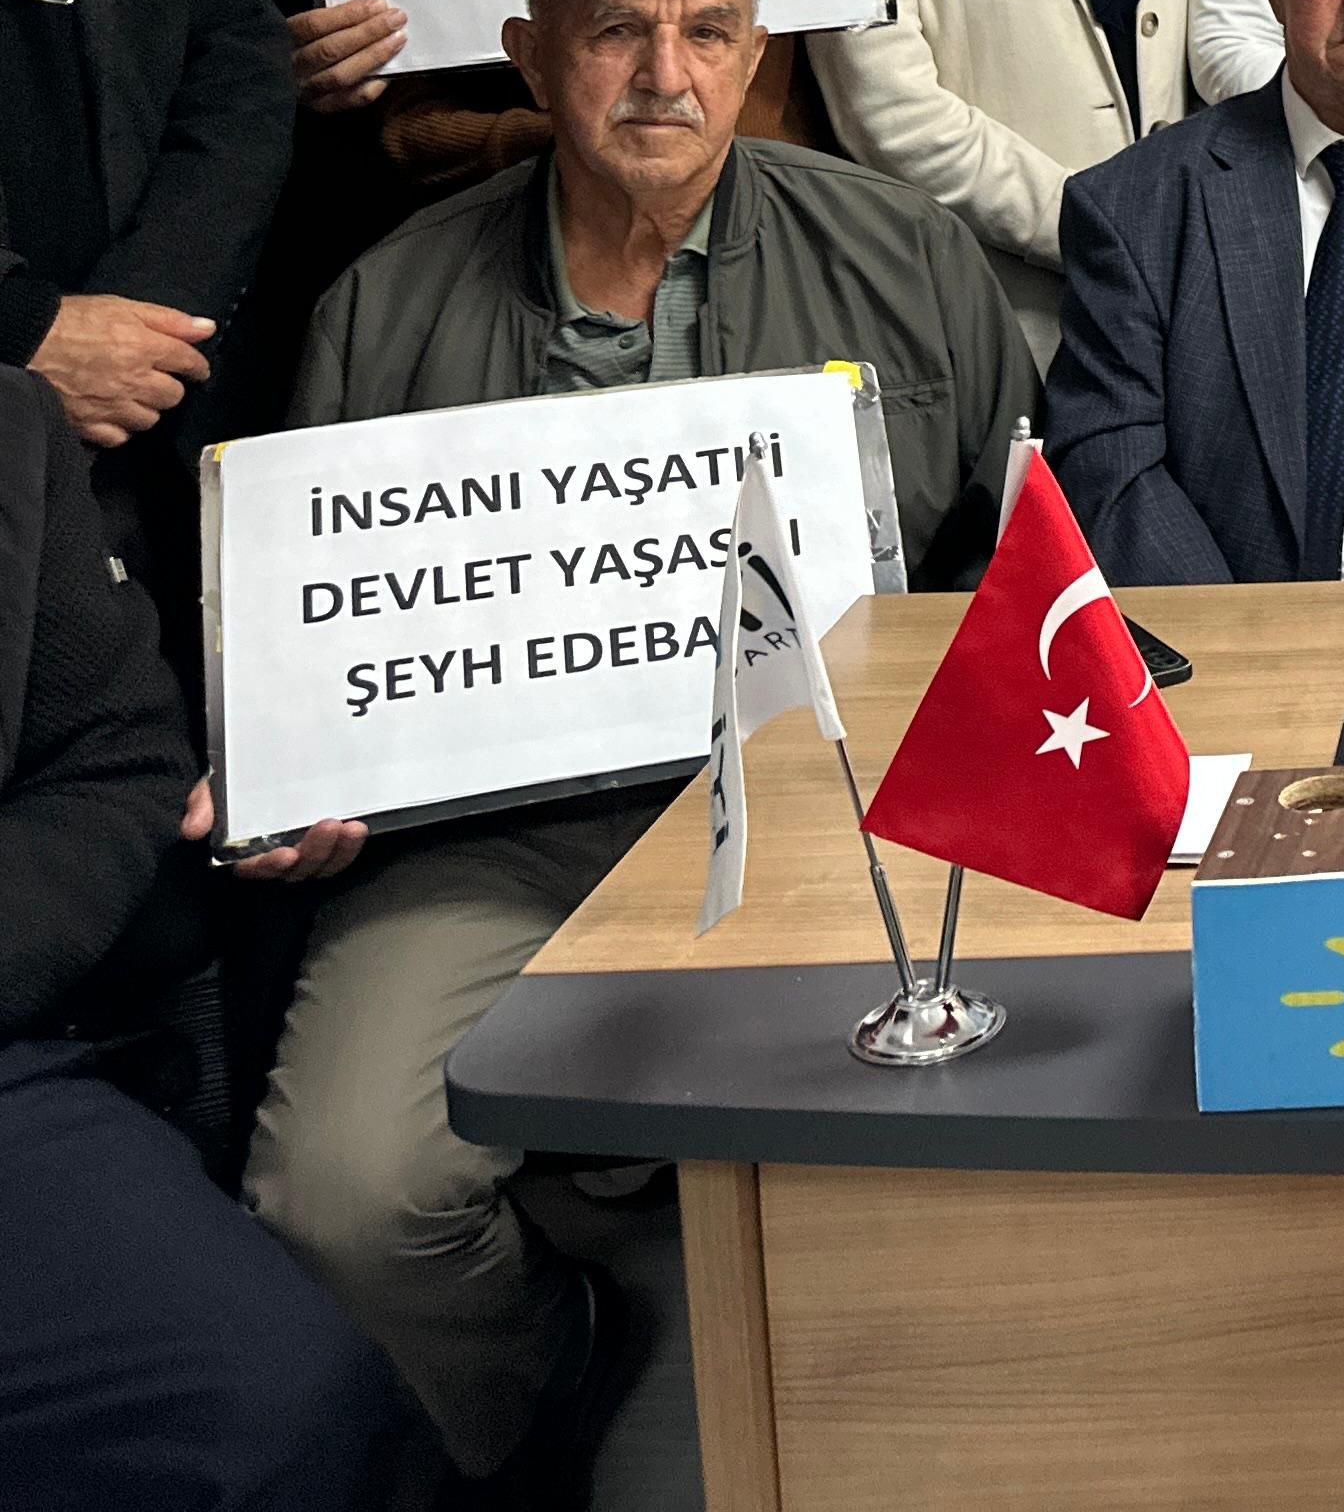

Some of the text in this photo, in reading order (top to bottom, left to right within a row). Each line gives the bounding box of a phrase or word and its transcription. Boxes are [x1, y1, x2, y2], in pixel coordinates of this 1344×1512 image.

[312, 471, 520, 536] İNSANI
[303, 554, 532, 624] DEVLET
[346, 616, 720, 718] ŞEYH EDEBA
